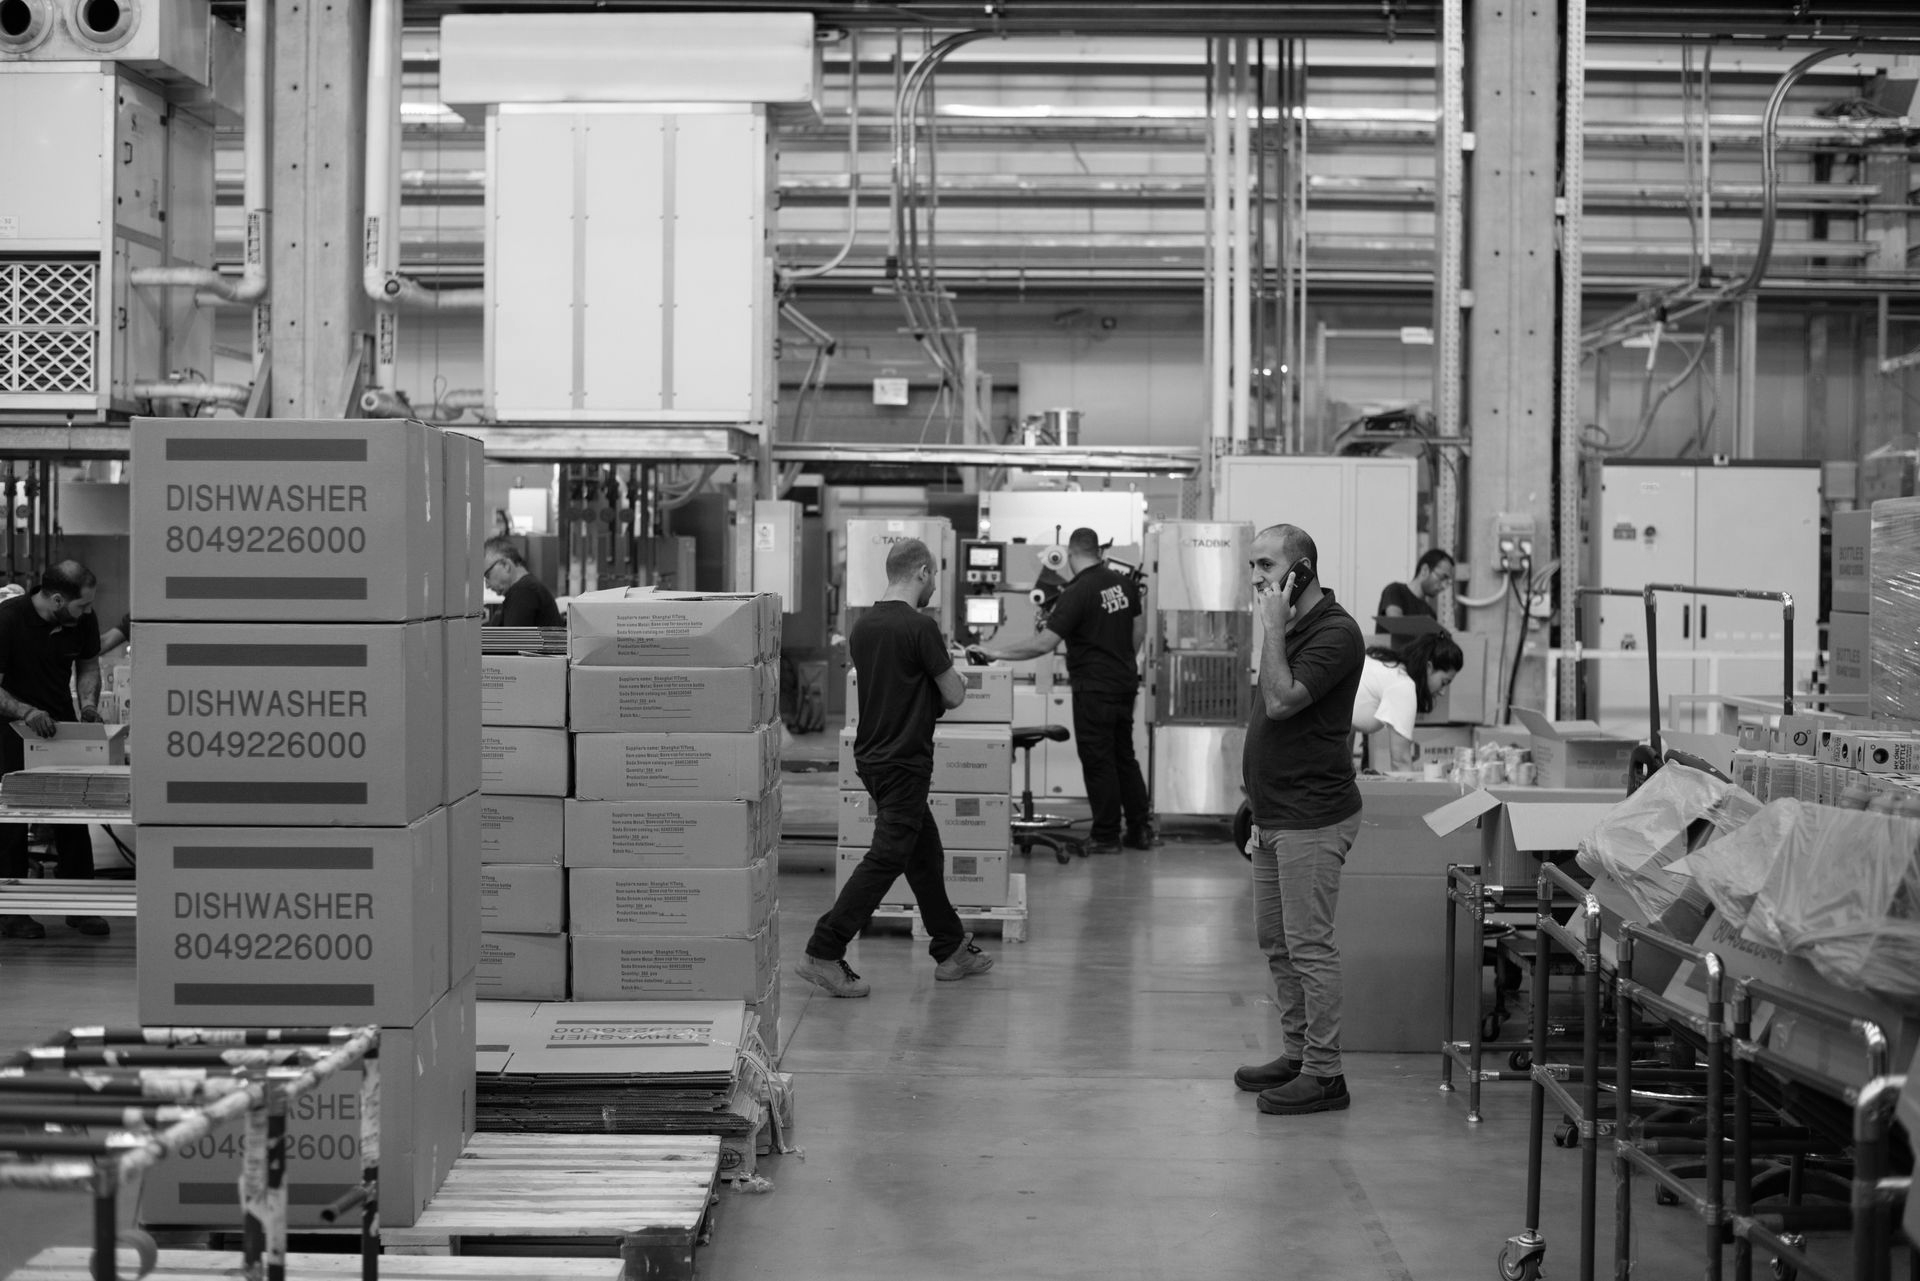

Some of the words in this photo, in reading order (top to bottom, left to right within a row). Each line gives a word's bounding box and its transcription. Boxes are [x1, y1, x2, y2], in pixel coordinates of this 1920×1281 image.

[167, 485, 366, 512] DISHWASHER
[166, 526, 365, 553] 8049226000
[168, 690, 367, 717] DISHWASHER
[167, 731, 366, 758] 8049226000
[175, 892, 373, 919] DISHWASHER
[175, 933, 372, 960] 8049226000
